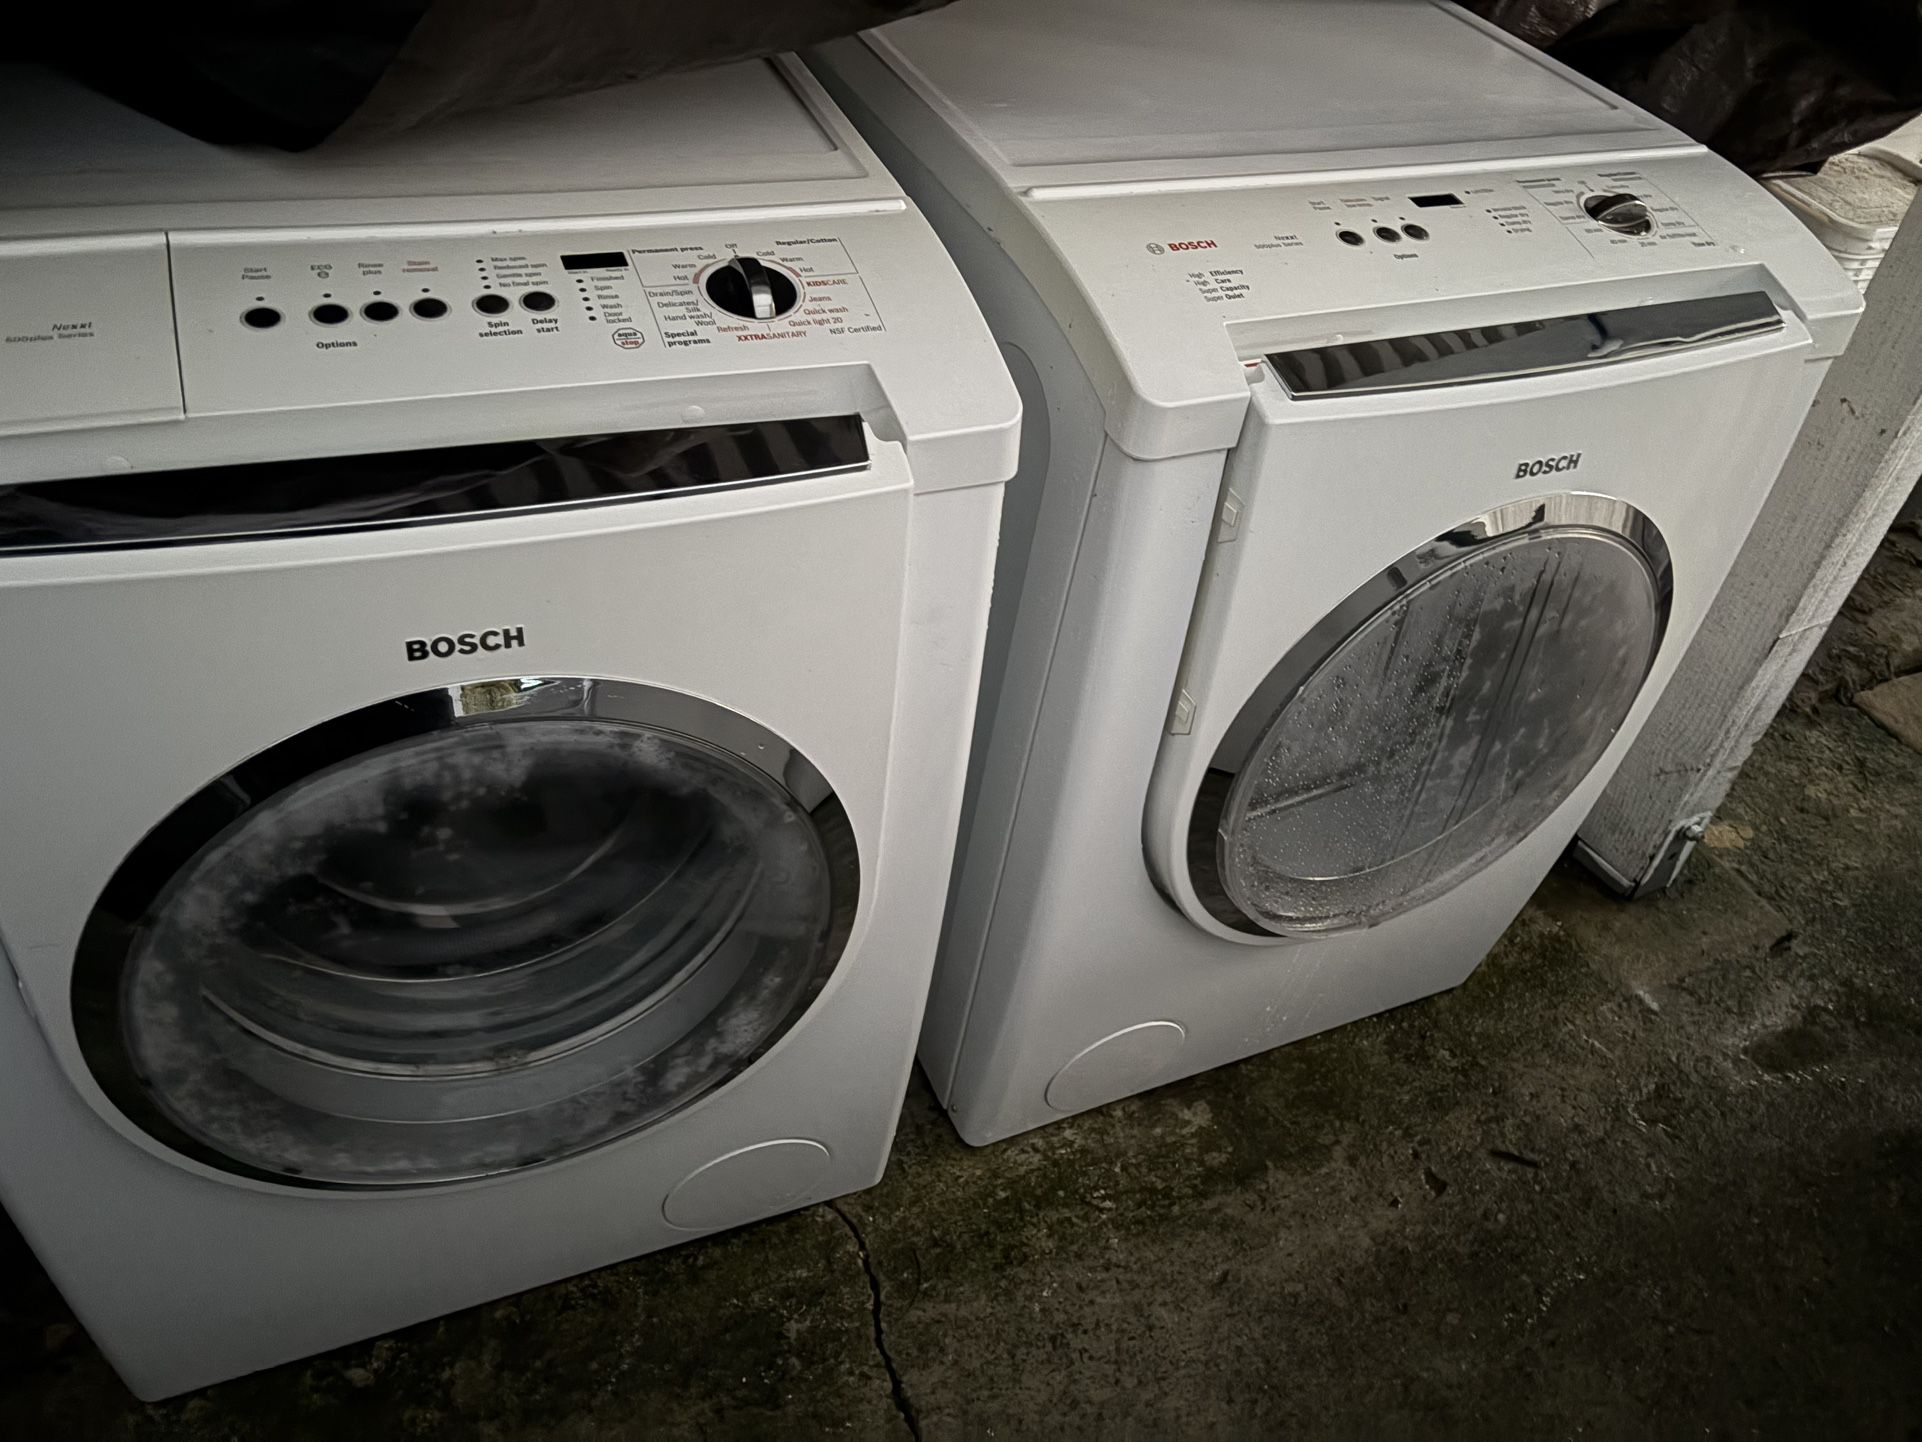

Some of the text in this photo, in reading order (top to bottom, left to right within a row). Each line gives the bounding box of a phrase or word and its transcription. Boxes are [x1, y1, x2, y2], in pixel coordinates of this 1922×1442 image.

[680, 245, 704, 253] press
[1168, 239, 1218, 252] BOSCH
[1209, 269, 1244, 277] Efficiency
[1219, 284, 1250, 292] Capacity
[648, 289, 694, 298] Drain/Spin
[1225, 292, 1245, 300] Quiet
[685, 306, 701, 314] Silk
[803, 306, 849, 316] Quick wash
[487, 320, 510, 329] Spin
[531, 317, 559, 326] Delay
[695, 319, 717, 328] Wool
[788, 316, 844, 328] Quick light 20
[478, 328, 523, 338] selection
[536, 325, 560, 334] start
[717, 325, 750, 334] Refresh
[829, 324, 883, 336] NSF Certified
[617, 331, 638, 339] aqua
[664, 330, 699, 339] Special
[736, 330, 808, 342] XXTRASANITARY
[316, 340, 358, 350] Options
[620, 339, 640, 347] stop
[667, 337, 712, 348] programs
[1514, 452, 1582, 480] BOSCH
[405, 626, 526, 662] BOSCH
